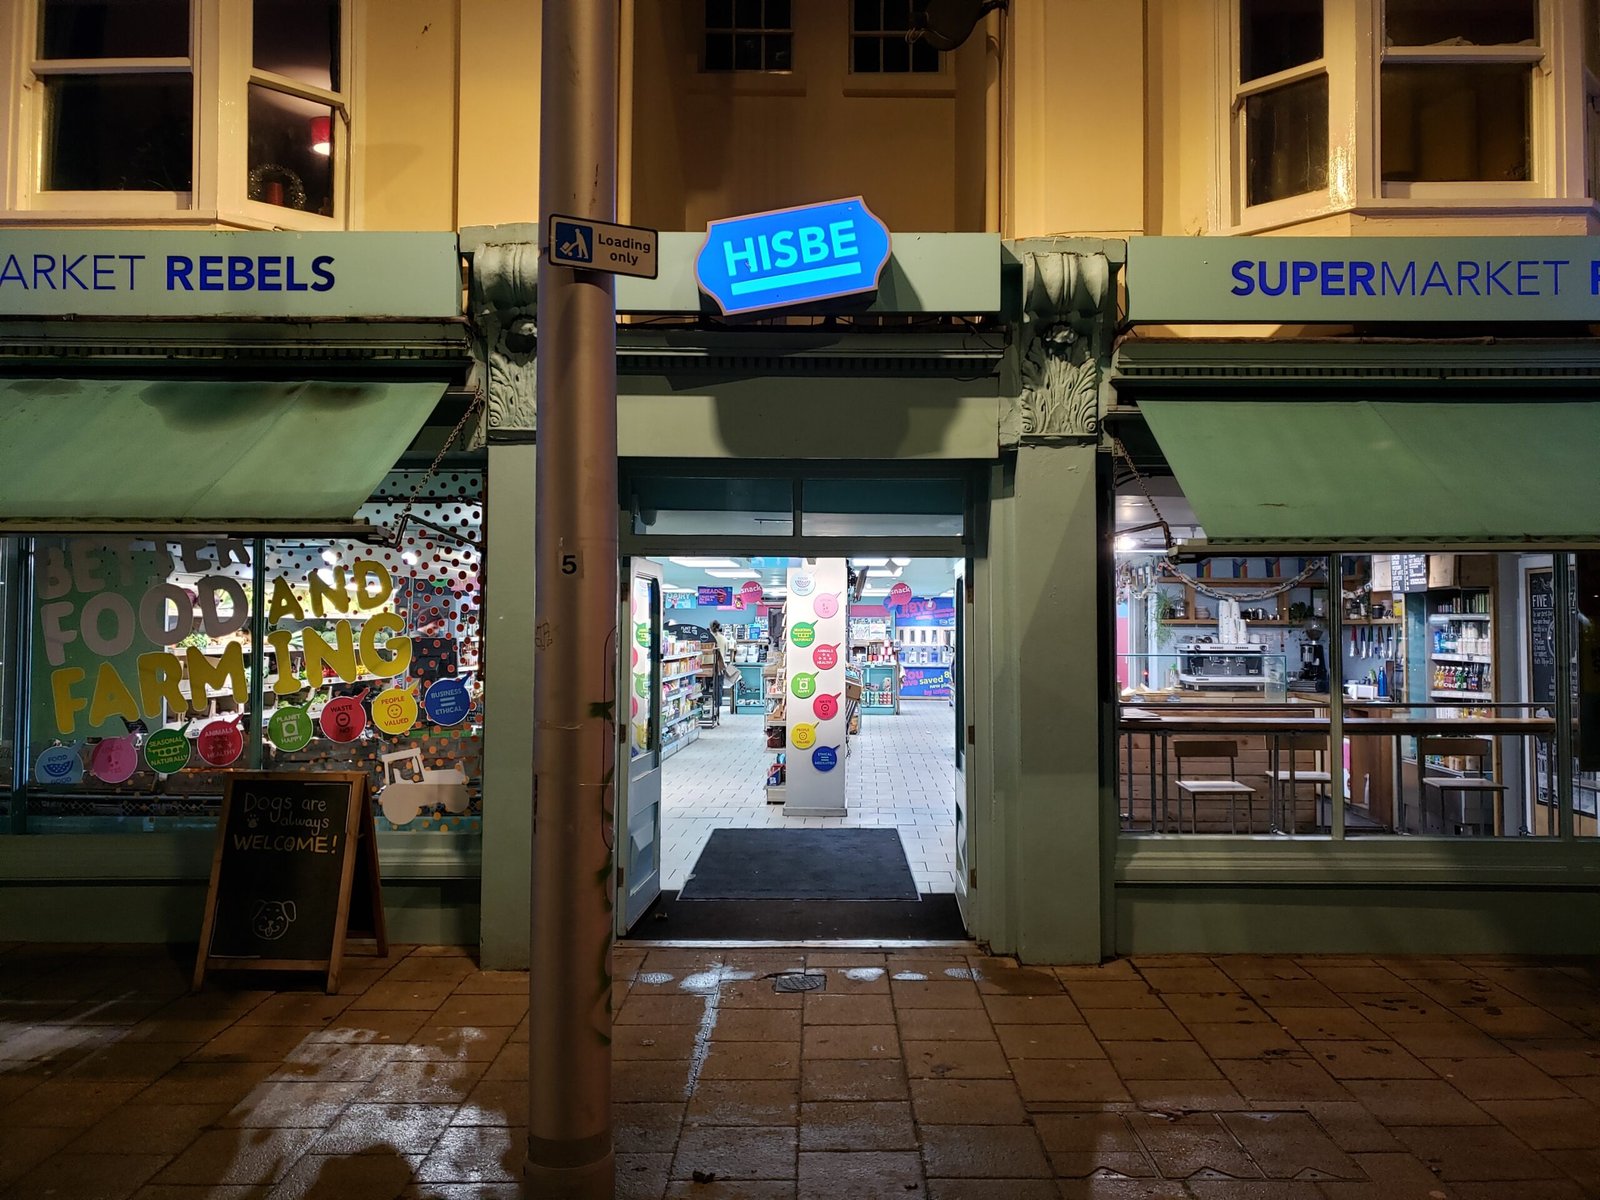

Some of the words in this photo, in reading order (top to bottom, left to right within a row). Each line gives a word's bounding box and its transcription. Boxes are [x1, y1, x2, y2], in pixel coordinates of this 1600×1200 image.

[598, 233, 651, 254] Loading
[723, 220, 859, 277] HISBE
[610, 250, 639, 267] only
[166, 255, 336, 292] REBELS
[1231, 260, 1570, 296] SUPERMARKET
[561, 555, 577, 575] 5
[740, 584, 761, 594] snack
[890, 586, 911, 596] snack
[40, 574, 249, 666] FOOD
[268, 560, 393, 624] AND
[51, 612, 413, 735] FARMING
[919, 675, 944, 685] saved
[431, 688, 462, 699] BUSINESS
[381, 696, 405, 705] PEOPLE
[330, 704, 353, 713] WASTE
[435, 706, 463, 716] ETHICAL
[276, 713, 301, 723] PLANET
[384, 717, 409, 727] VALUED
[205, 727, 234, 738] ANIMALS
[149, 735, 182, 748] SEASONAL
[281, 735, 303, 745] HAPPY
[47, 754, 68, 763] FOOD
[207, 748, 236, 759] HEALTHY
[150, 754, 188, 766] NATURALLY
[243, 792, 293, 823] Dogs
[301, 799, 328, 812] are
[280, 810, 330, 836] always
[233, 833, 337, 854] WELCOME!
